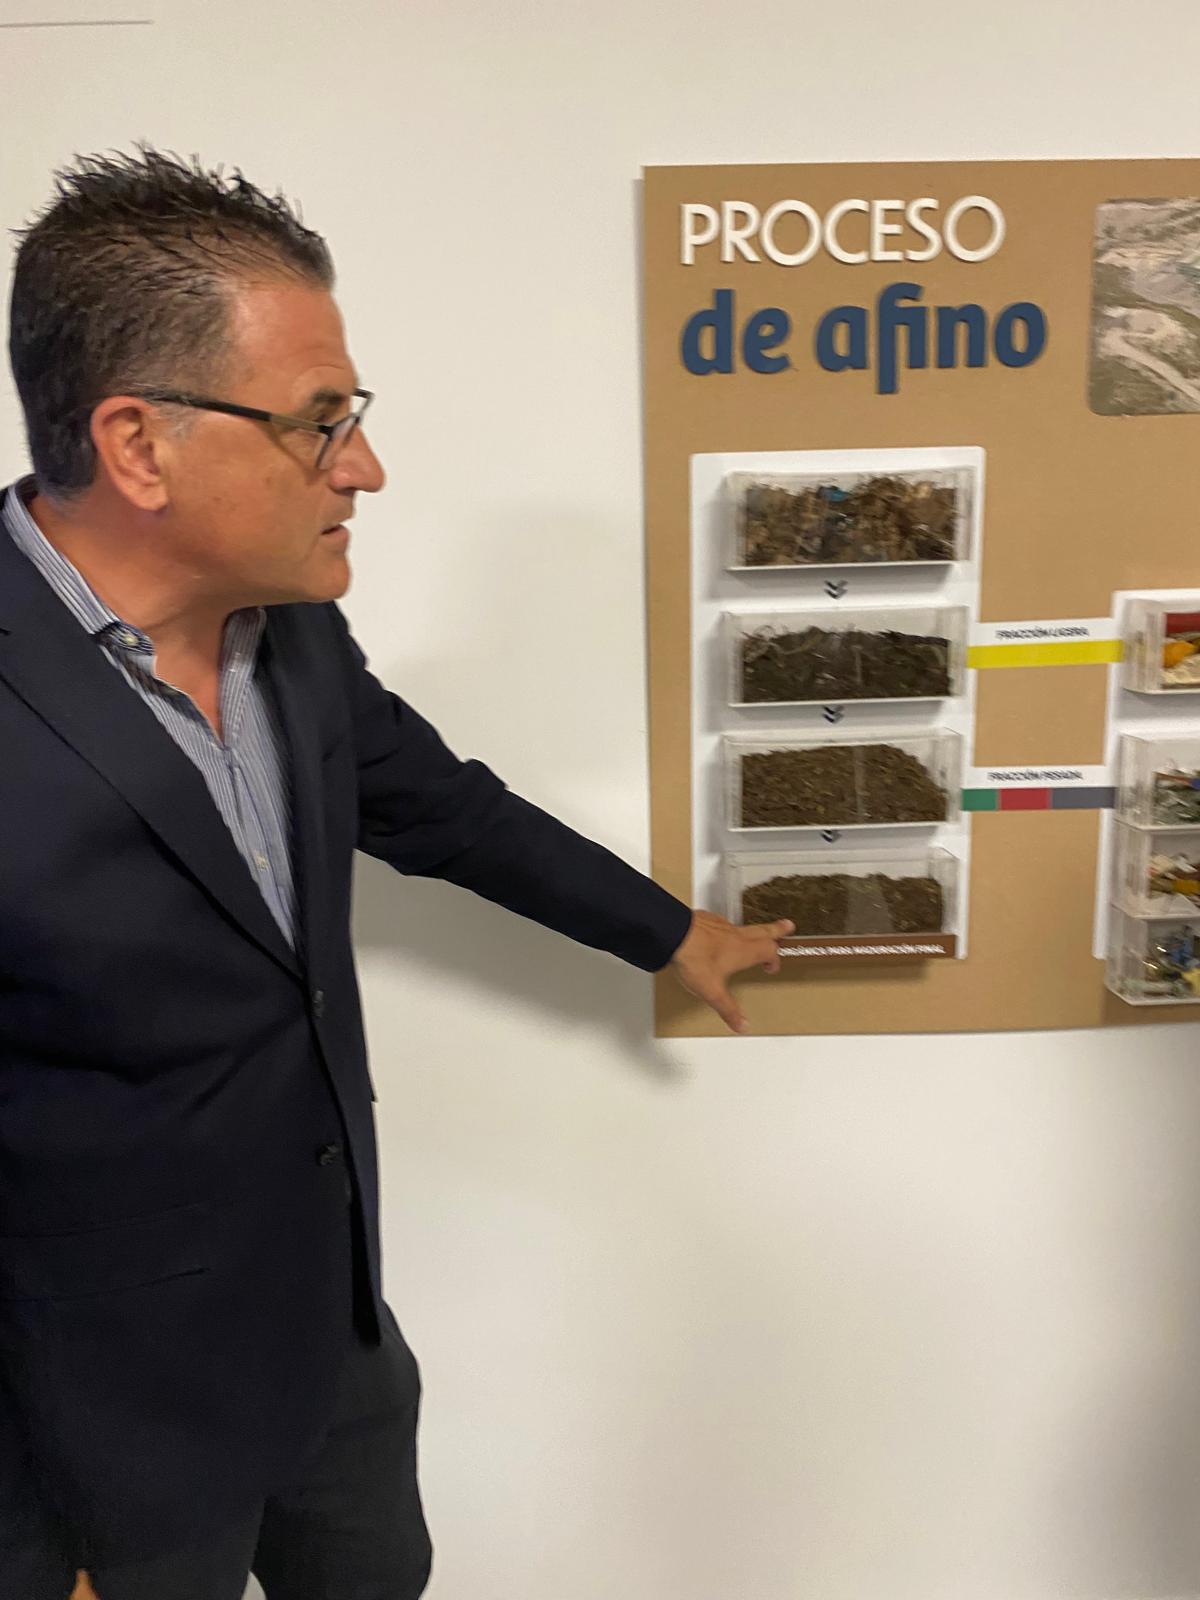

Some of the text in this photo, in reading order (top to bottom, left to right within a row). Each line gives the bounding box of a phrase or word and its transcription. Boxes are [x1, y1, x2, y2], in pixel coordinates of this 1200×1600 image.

[680, 195, 1006, 266] PROCESO
[681, 281, 1048, 395] de afino
